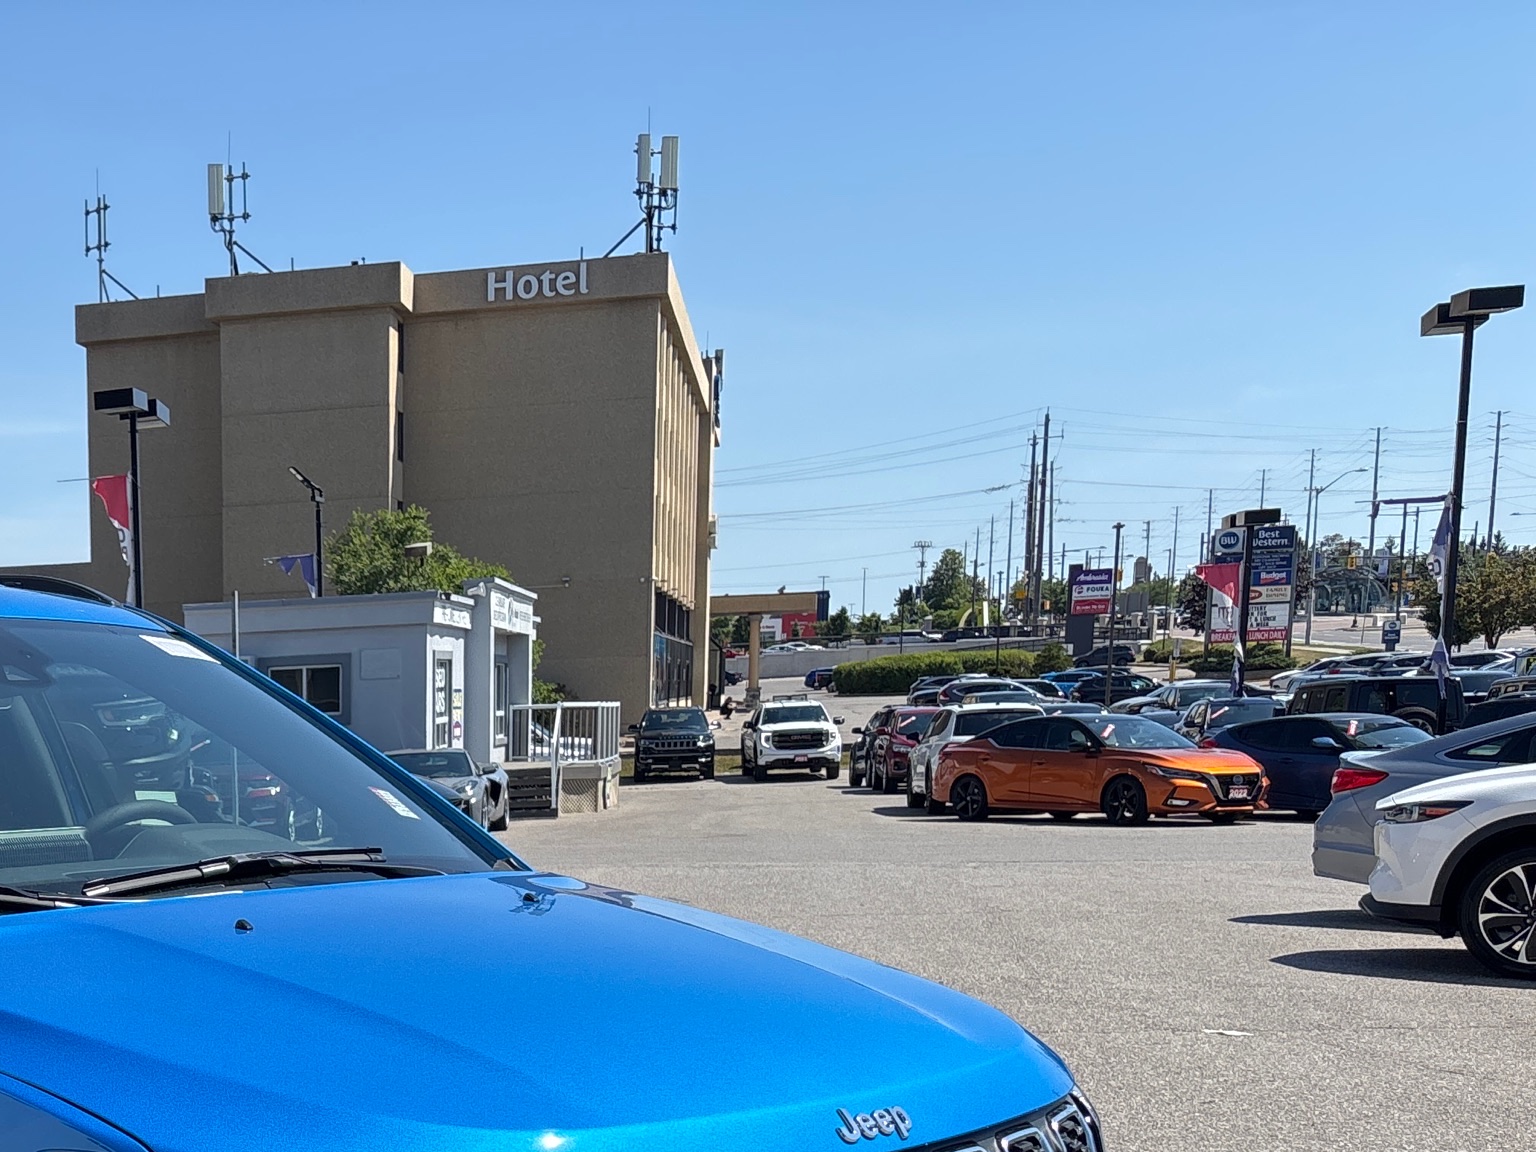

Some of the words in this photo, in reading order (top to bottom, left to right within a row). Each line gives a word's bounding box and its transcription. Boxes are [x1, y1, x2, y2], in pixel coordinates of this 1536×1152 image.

[487, 262, 590, 302] Hotel
[1258, 530, 1280, 538] Best
[1260, 571, 1287, 580] Budget
[1211, 632, 1236, 642] BREAKFA
[1249, 631, 1268, 641] LUNCH
[1268, 630, 1287, 640] DAILY
[1228, 788, 1248, 800] 2022
[835, 1105, 913, 1145] Jeep
